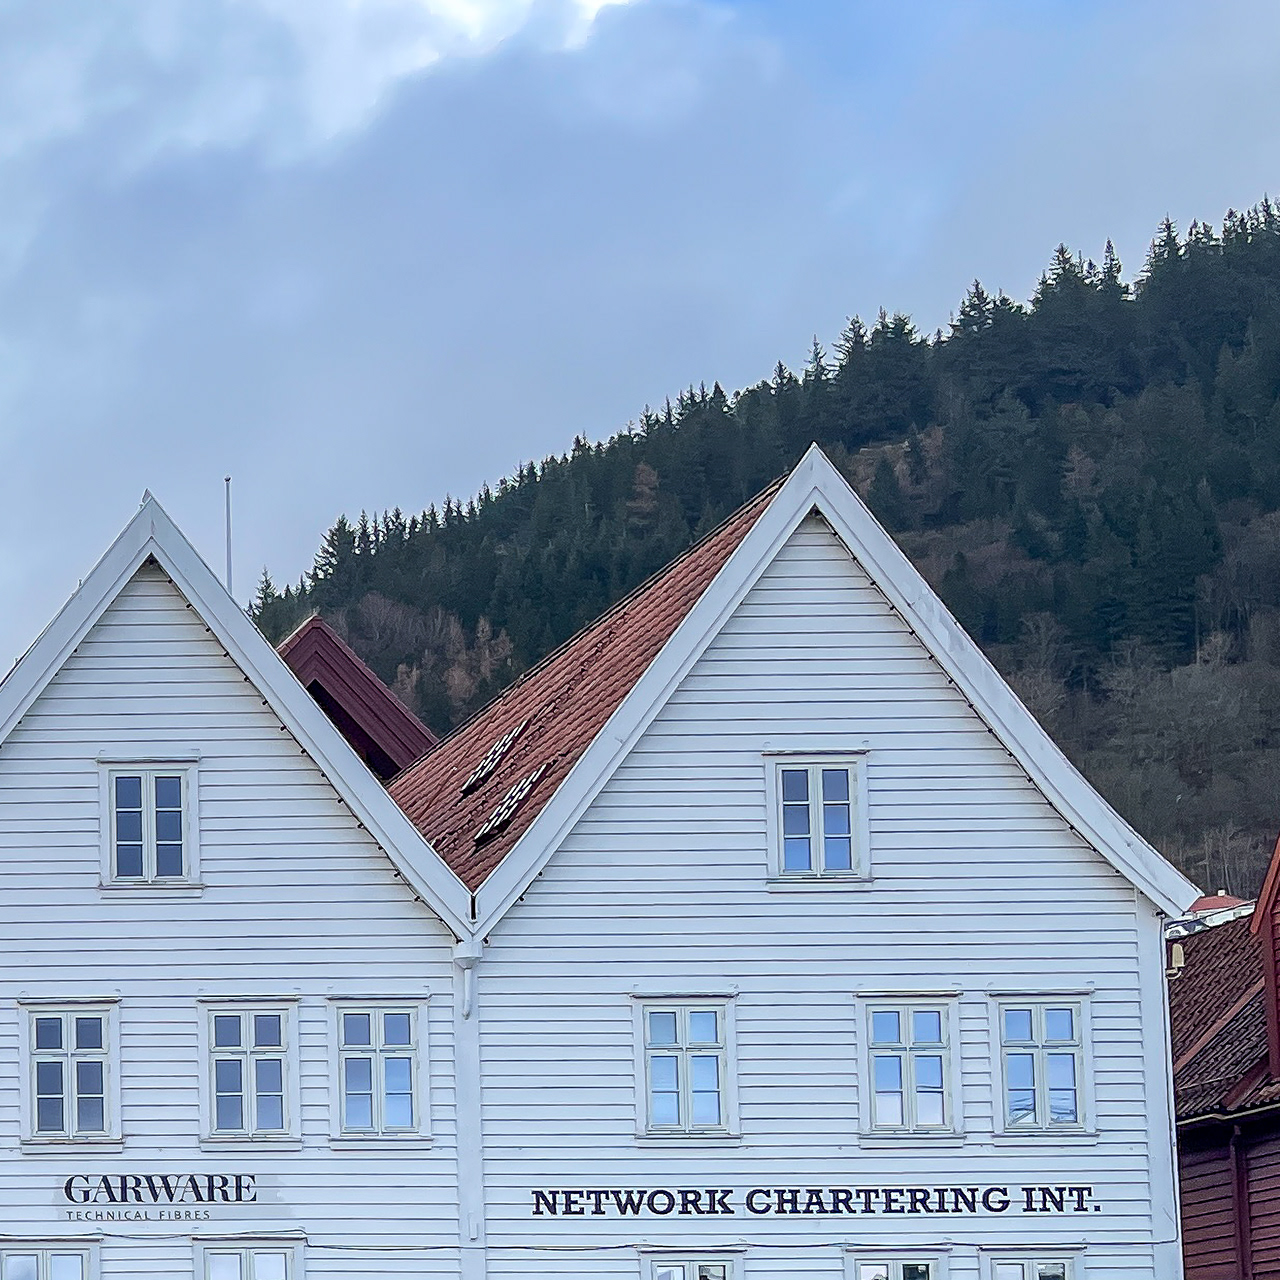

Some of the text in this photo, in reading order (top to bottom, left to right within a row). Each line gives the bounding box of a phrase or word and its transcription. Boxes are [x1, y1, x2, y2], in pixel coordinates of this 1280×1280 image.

[63, 1173, 258, 1205] GARWARE
[531, 1185, 1103, 1217] NETWORK CHARTERING INT.
[66, 1210, 211, 1221] TECHNICAL FIBRES
